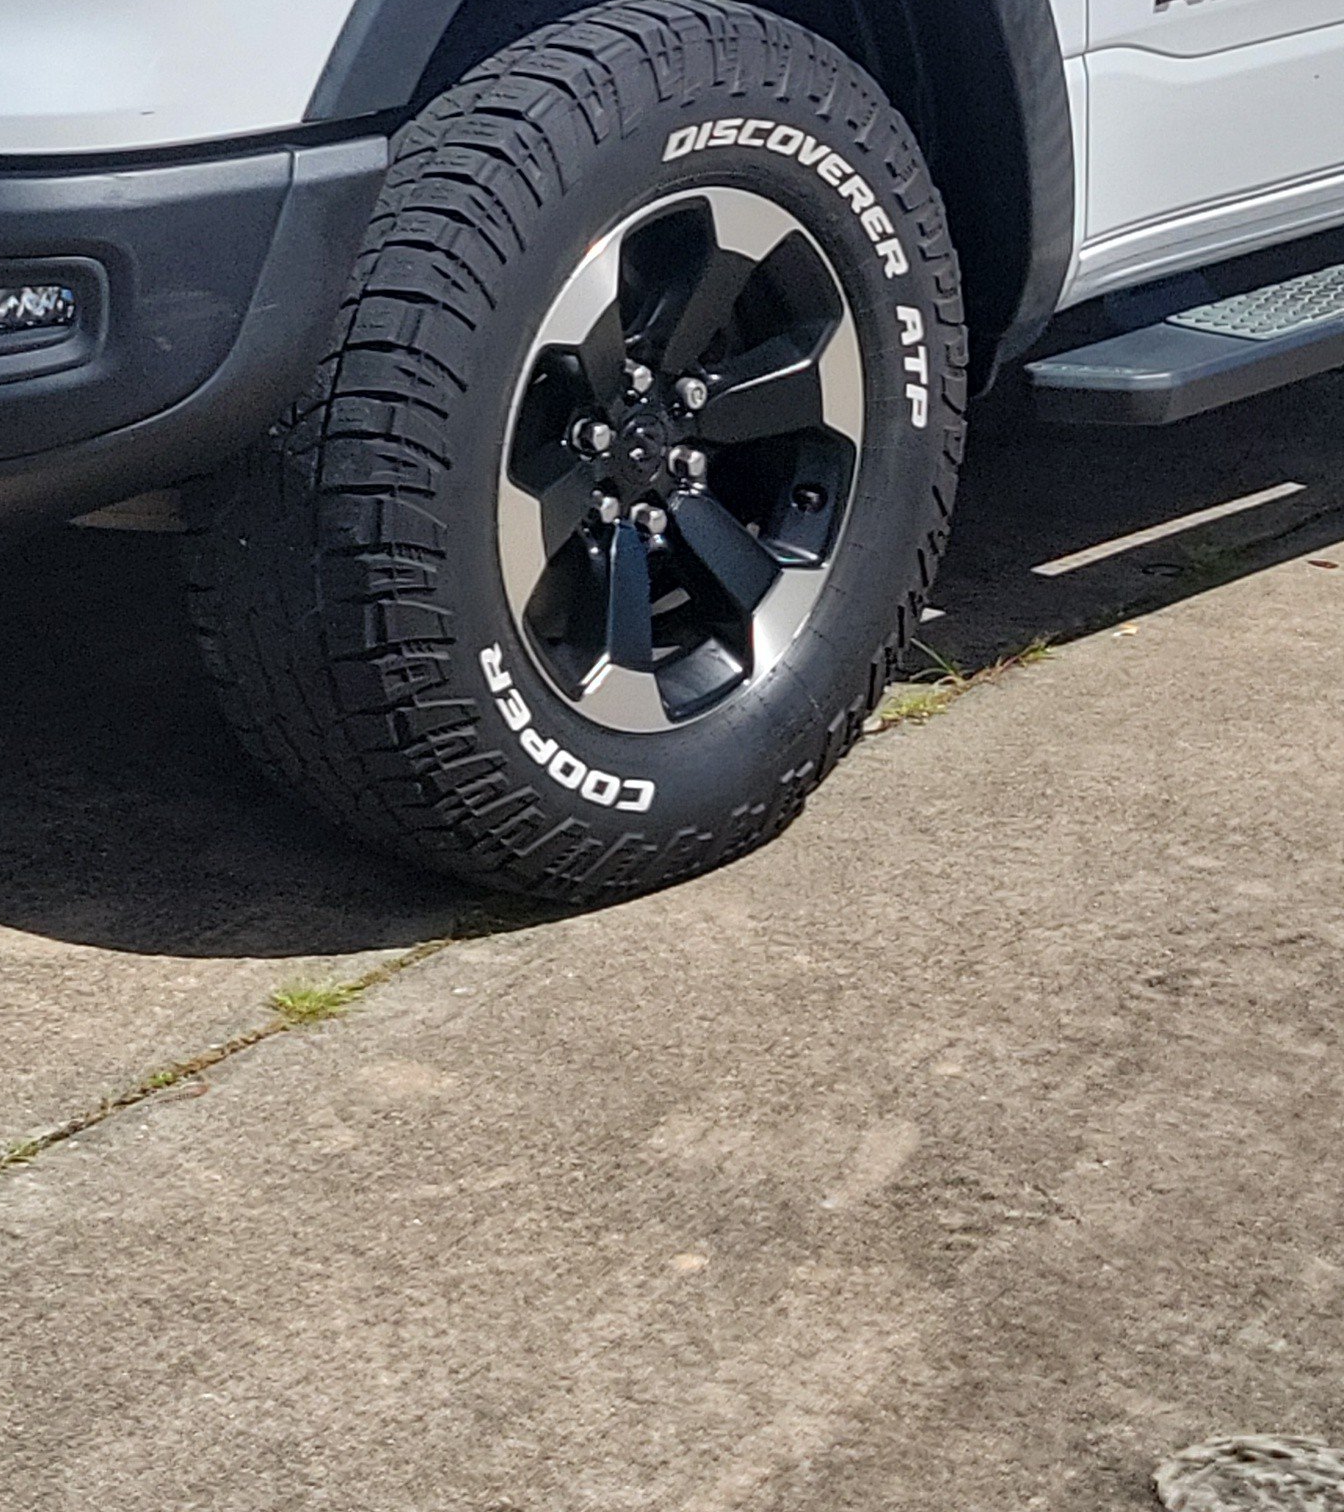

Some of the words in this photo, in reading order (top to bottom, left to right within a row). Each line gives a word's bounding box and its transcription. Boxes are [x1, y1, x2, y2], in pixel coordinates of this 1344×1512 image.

[662, 118, 909, 279] DISCOVERER
[896, 305, 928, 429] ATP
[479, 642, 655, 812] COOPER
